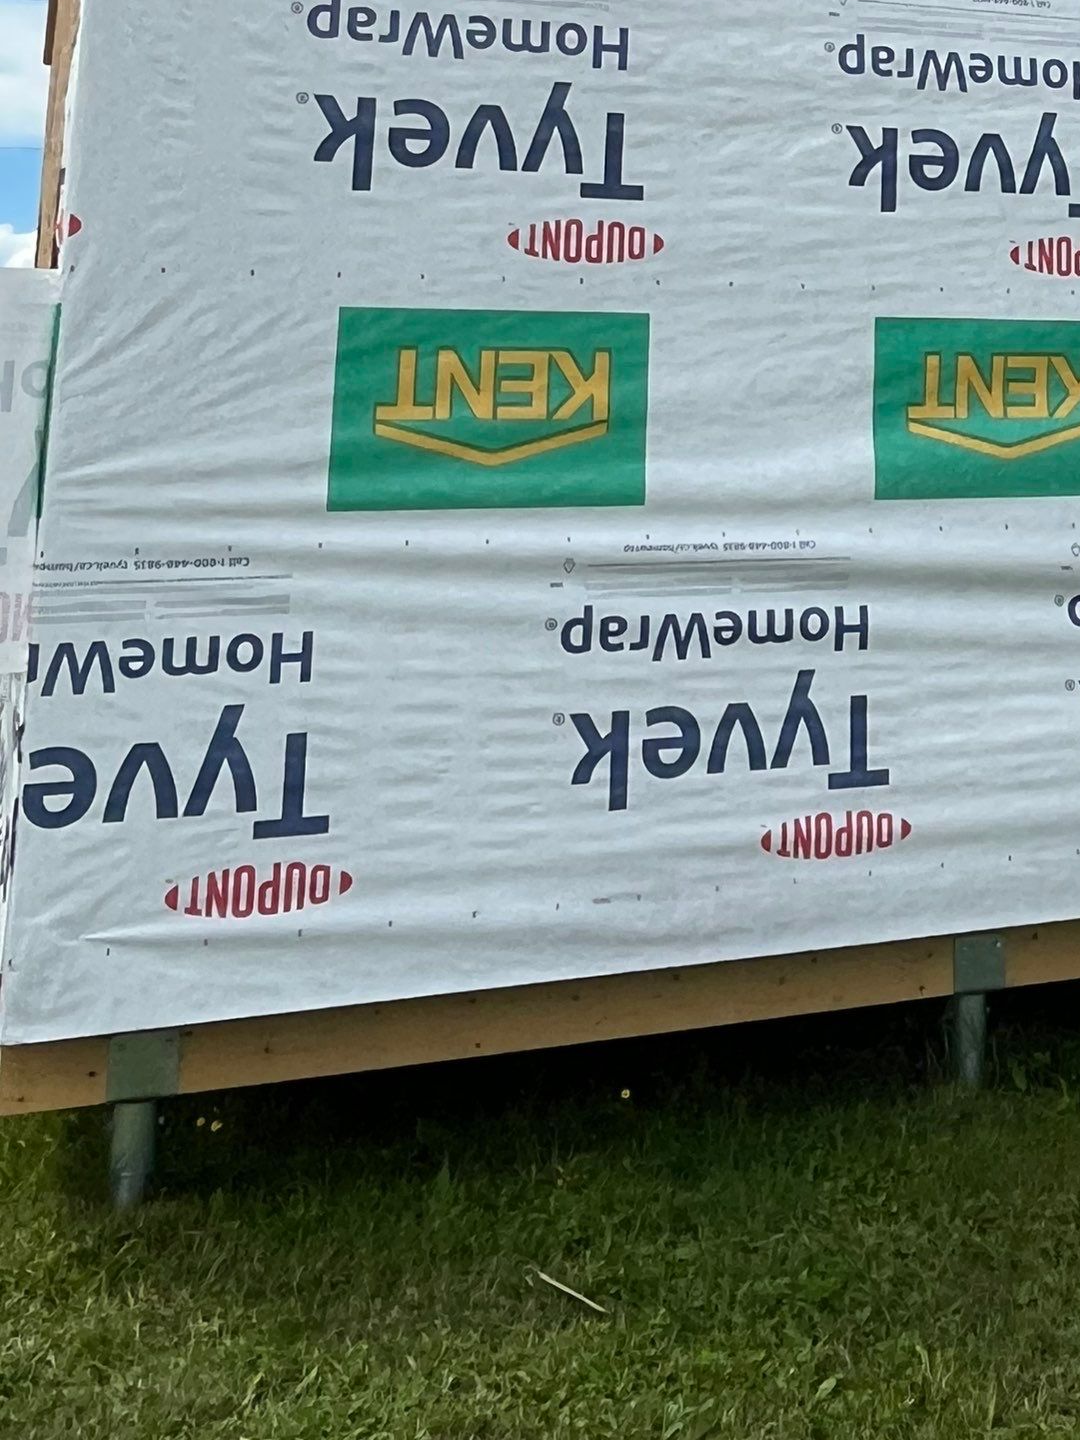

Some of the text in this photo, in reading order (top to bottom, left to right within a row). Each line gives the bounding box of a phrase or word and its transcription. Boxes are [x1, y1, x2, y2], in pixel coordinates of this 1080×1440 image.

[314, 82, 643, 200] Tyvek
[525, 219, 645, 263] DUPONT
[376, 347, 609, 421] KENT
[561, 605, 868, 661] HomeWrap
[570, 669, 889, 811] Tyvek
[778, 810, 893, 859] DUPONT
[184, 862, 330, 918] DUPONT
